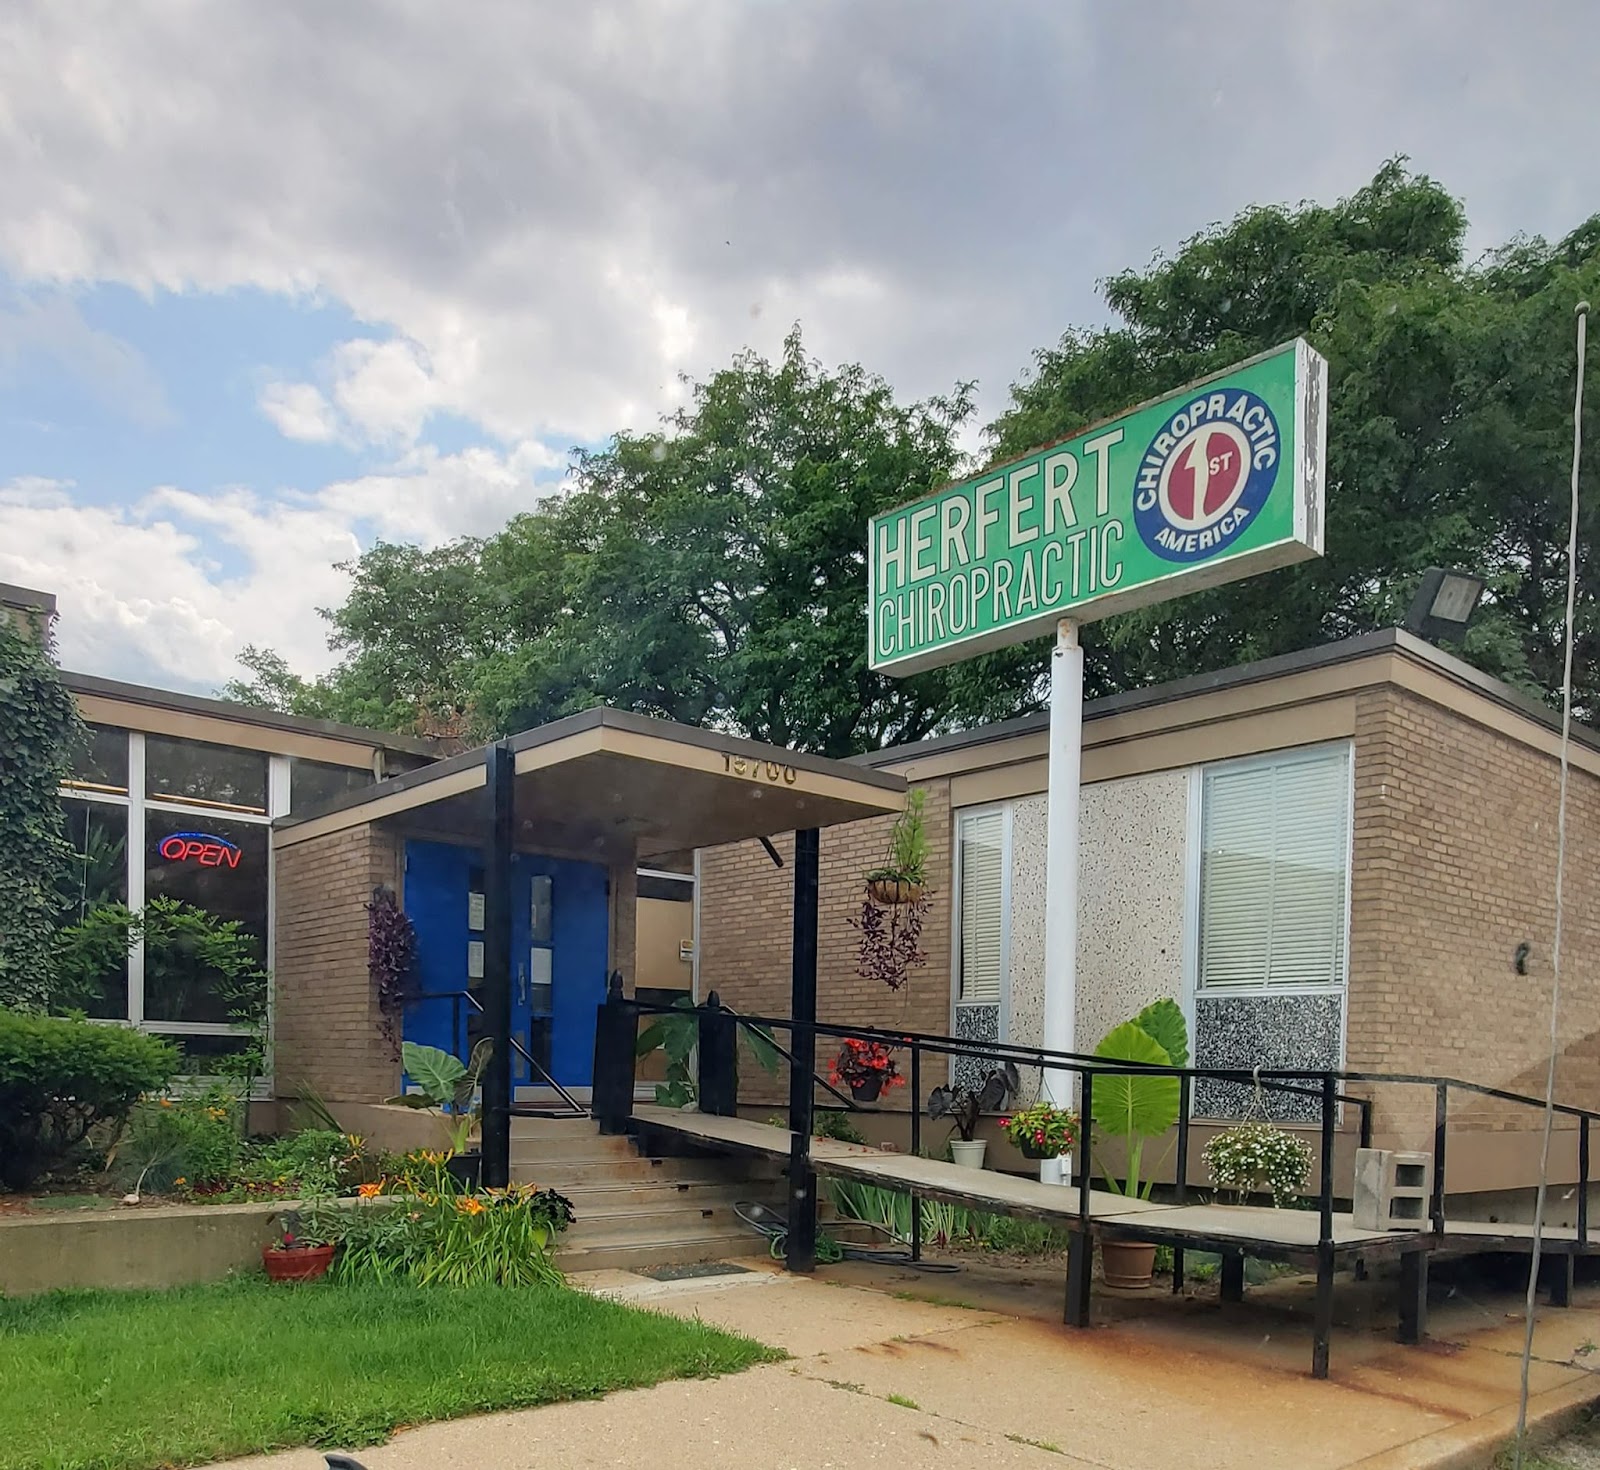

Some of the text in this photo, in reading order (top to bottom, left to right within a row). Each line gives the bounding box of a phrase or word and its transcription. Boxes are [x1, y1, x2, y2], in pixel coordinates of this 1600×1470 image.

[878, 427, 1124, 596] HERFERT
[1136, 393, 1277, 512] CHIROPRACTIC
[878, 519, 1124, 656] CHIROPRACTIC
[1154, 506, 1250, 553] AMERICA
[162, 838, 242, 868] OPEN
